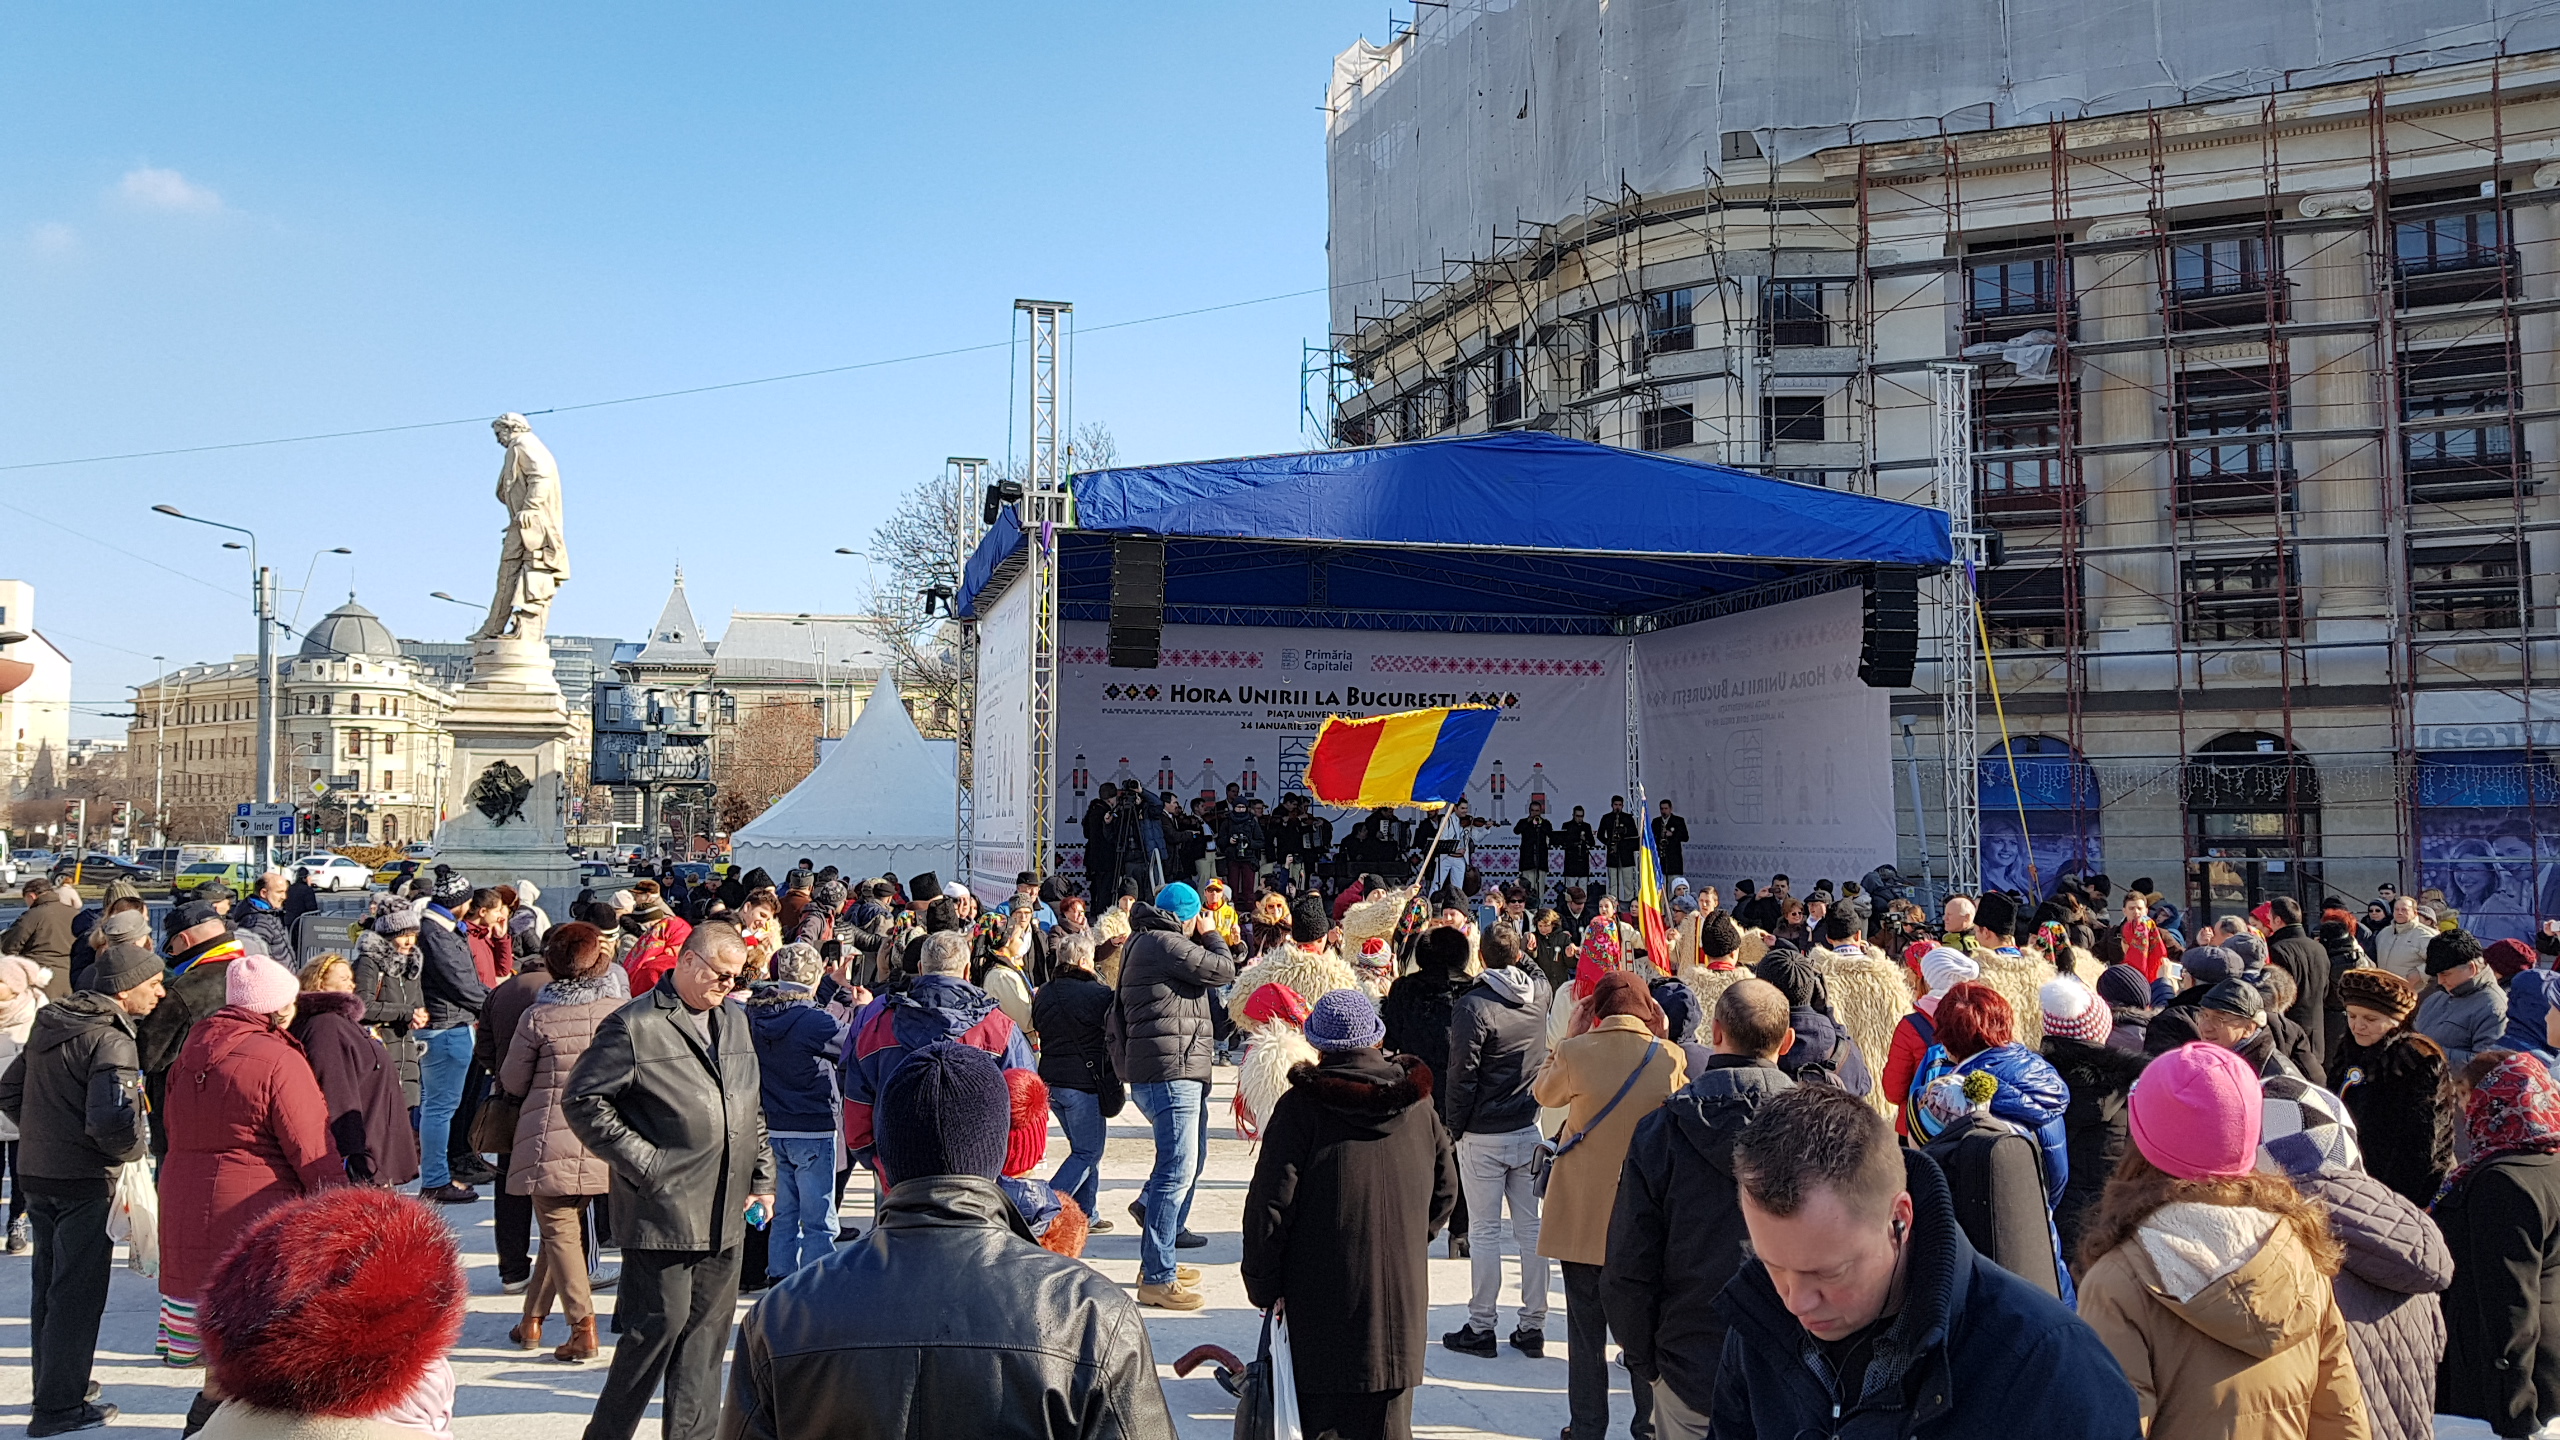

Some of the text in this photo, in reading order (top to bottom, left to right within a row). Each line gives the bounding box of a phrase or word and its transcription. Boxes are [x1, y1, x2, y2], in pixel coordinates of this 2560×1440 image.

[1305, 649, 1353, 661] Primăria
[1304, 661, 1353, 674] Capitalei
[1315, 691, 1341, 706] LA
[1240, 721, 1253, 730] 24
[1255, 722, 1302, 731] IANUARIE
[254, 822, 273, 831] Inter
